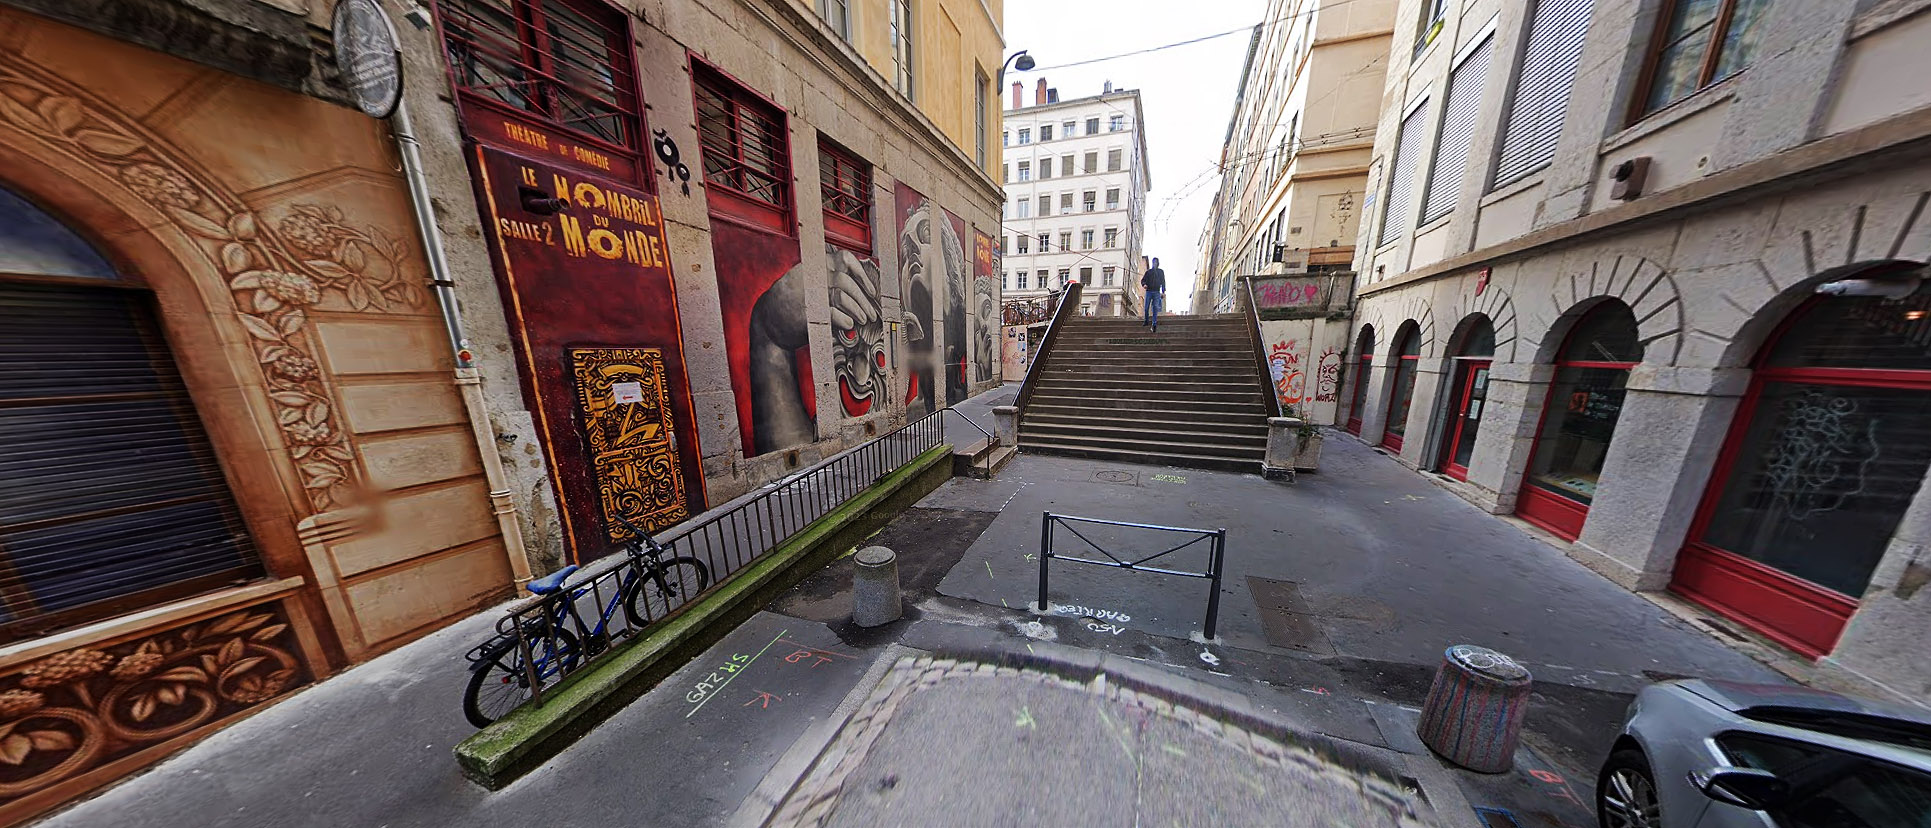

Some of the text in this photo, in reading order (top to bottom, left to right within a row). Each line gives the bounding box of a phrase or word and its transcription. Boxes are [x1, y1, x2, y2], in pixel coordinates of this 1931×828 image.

[521, 166, 538, 187] LE
[501, 218, 555, 246] SALLE 2
[593, 214, 609, 228] DU
[559, 213, 663, 268] MONDE
[686, 672, 724, 703] GAZ
